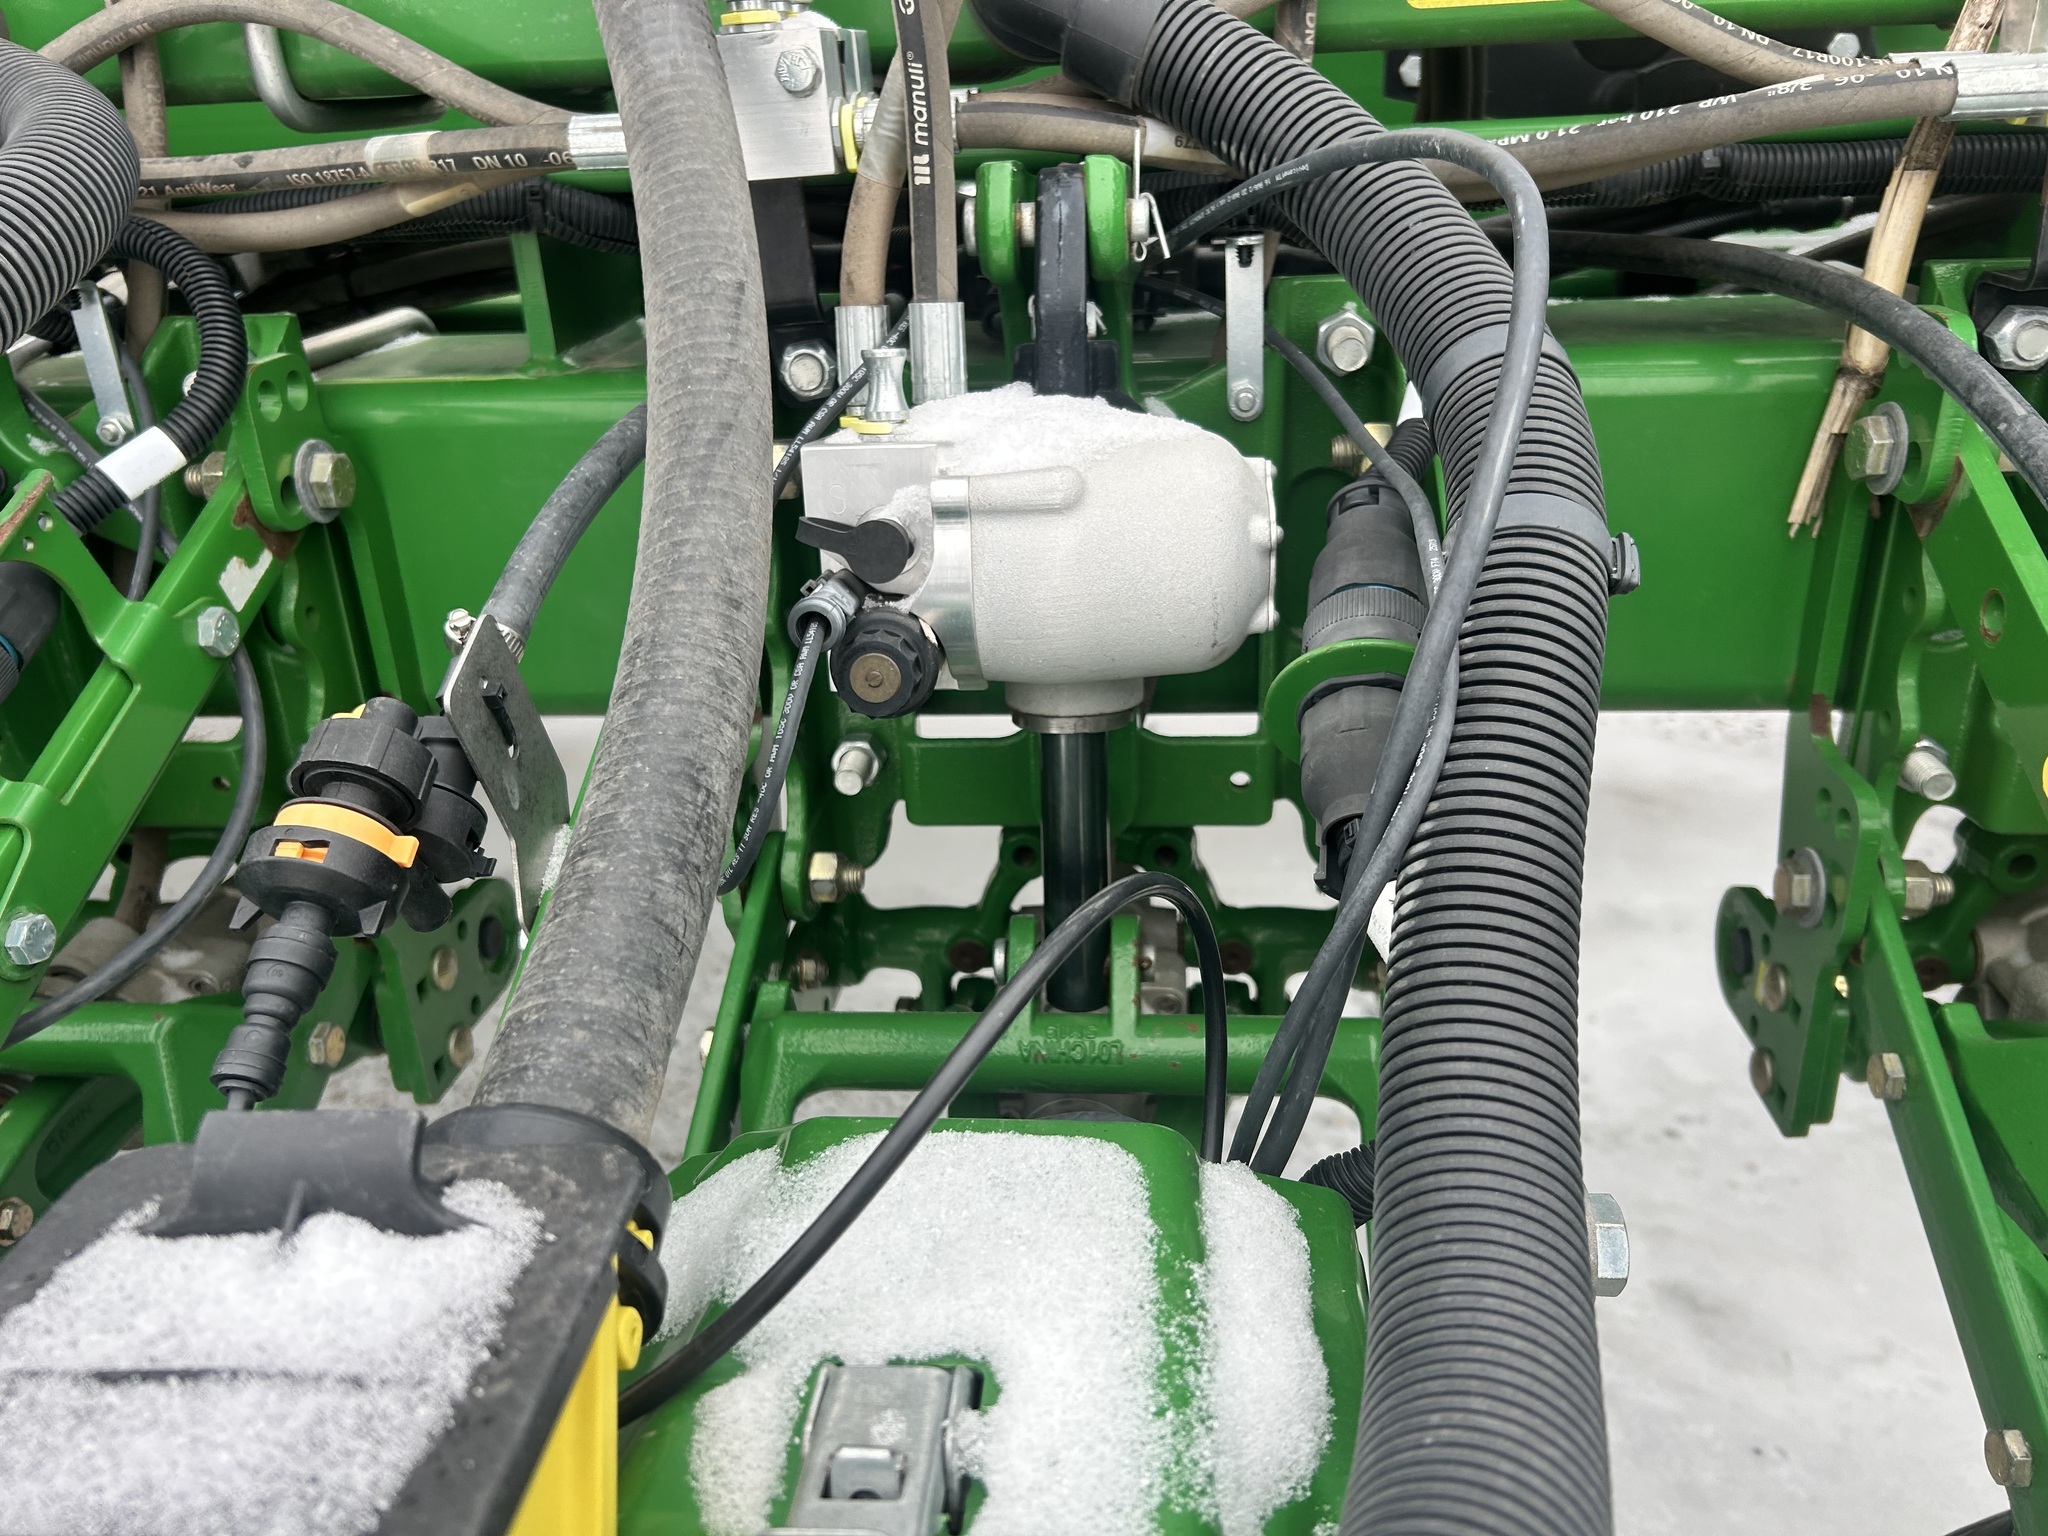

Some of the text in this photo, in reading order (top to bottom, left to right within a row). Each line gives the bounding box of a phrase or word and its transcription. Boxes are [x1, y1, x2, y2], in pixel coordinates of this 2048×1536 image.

[1741, 26, 1770, 46] DN
[1834, 73, 1875, 86] -06
[1895, 68, 1927, 79] 10
[286, 172, 314, 186] ISO
[471, 155, 502, 170] DN
[504, 152, 529, 168] 10
